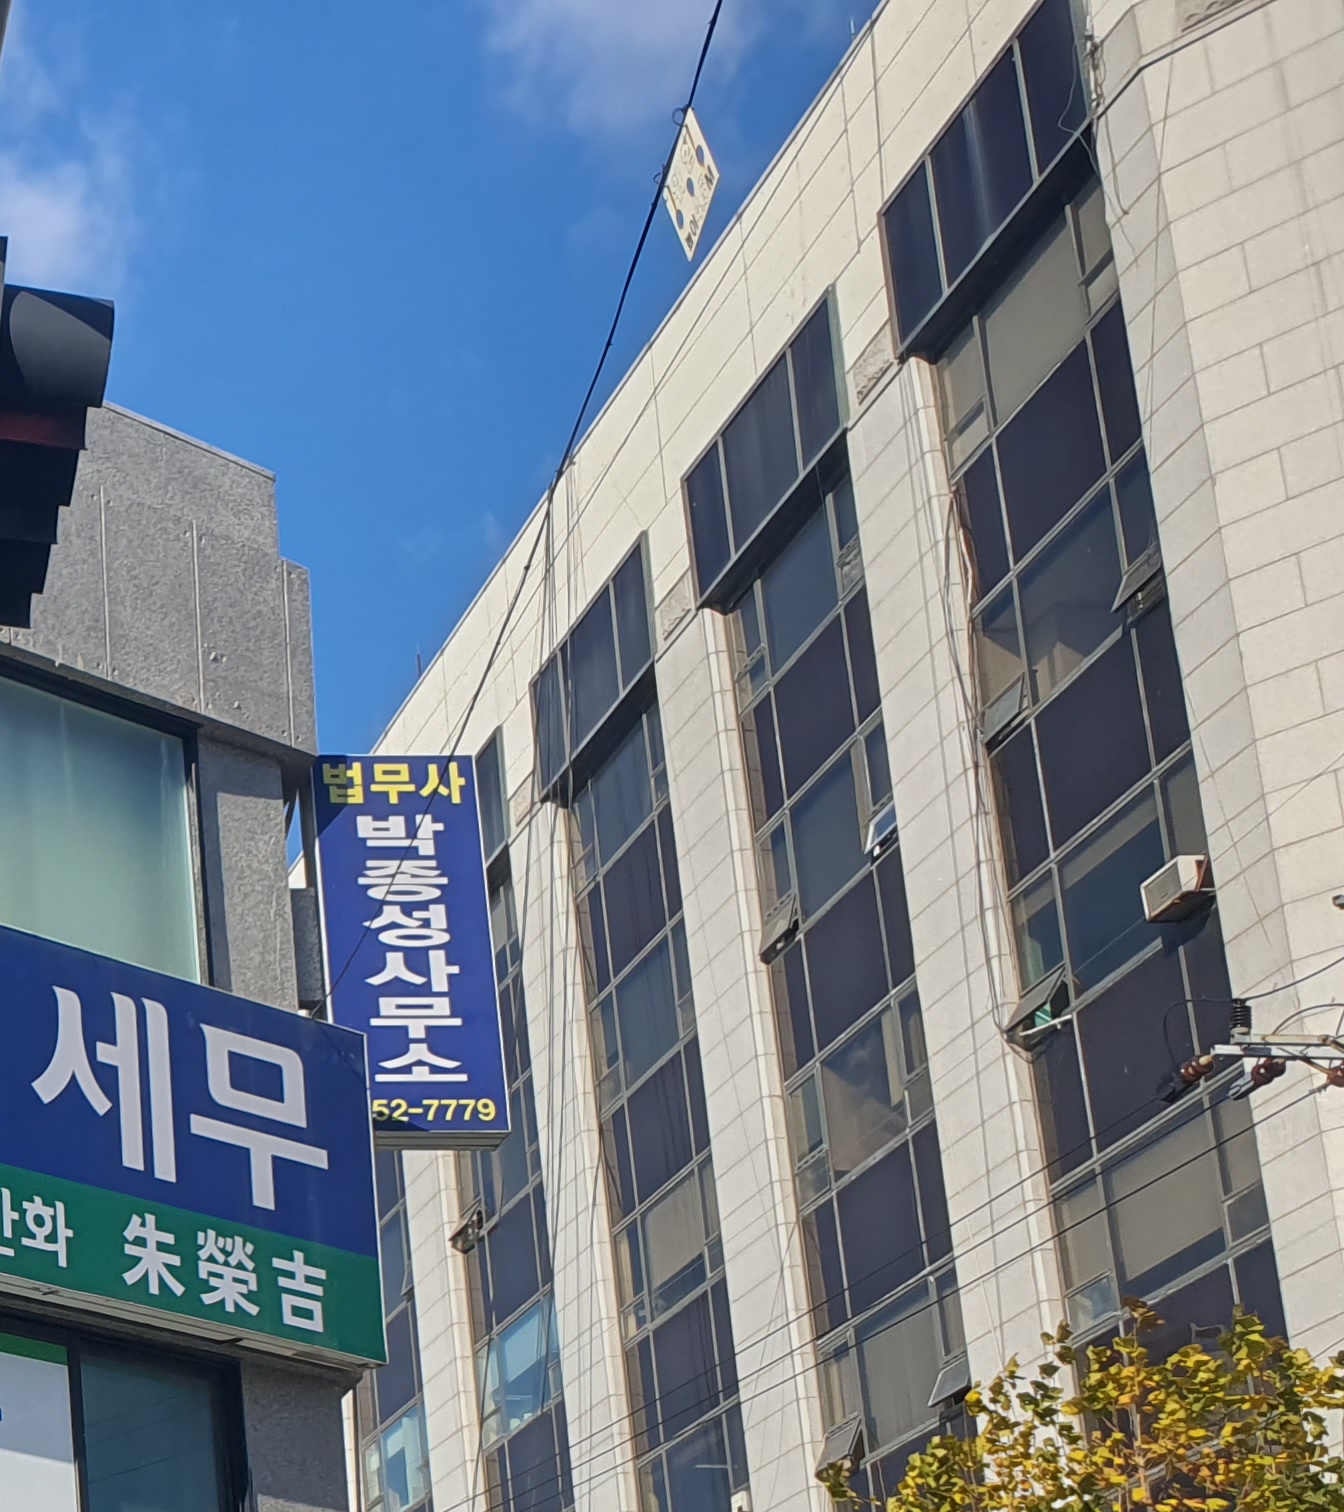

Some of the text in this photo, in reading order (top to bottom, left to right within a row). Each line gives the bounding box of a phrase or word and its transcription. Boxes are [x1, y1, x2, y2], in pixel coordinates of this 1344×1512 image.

[322, 762, 465, 804] 법무사
[356, 813, 468, 1083] 박종성사무소
[122, 1211, 328, 1335] 朱榮吉
